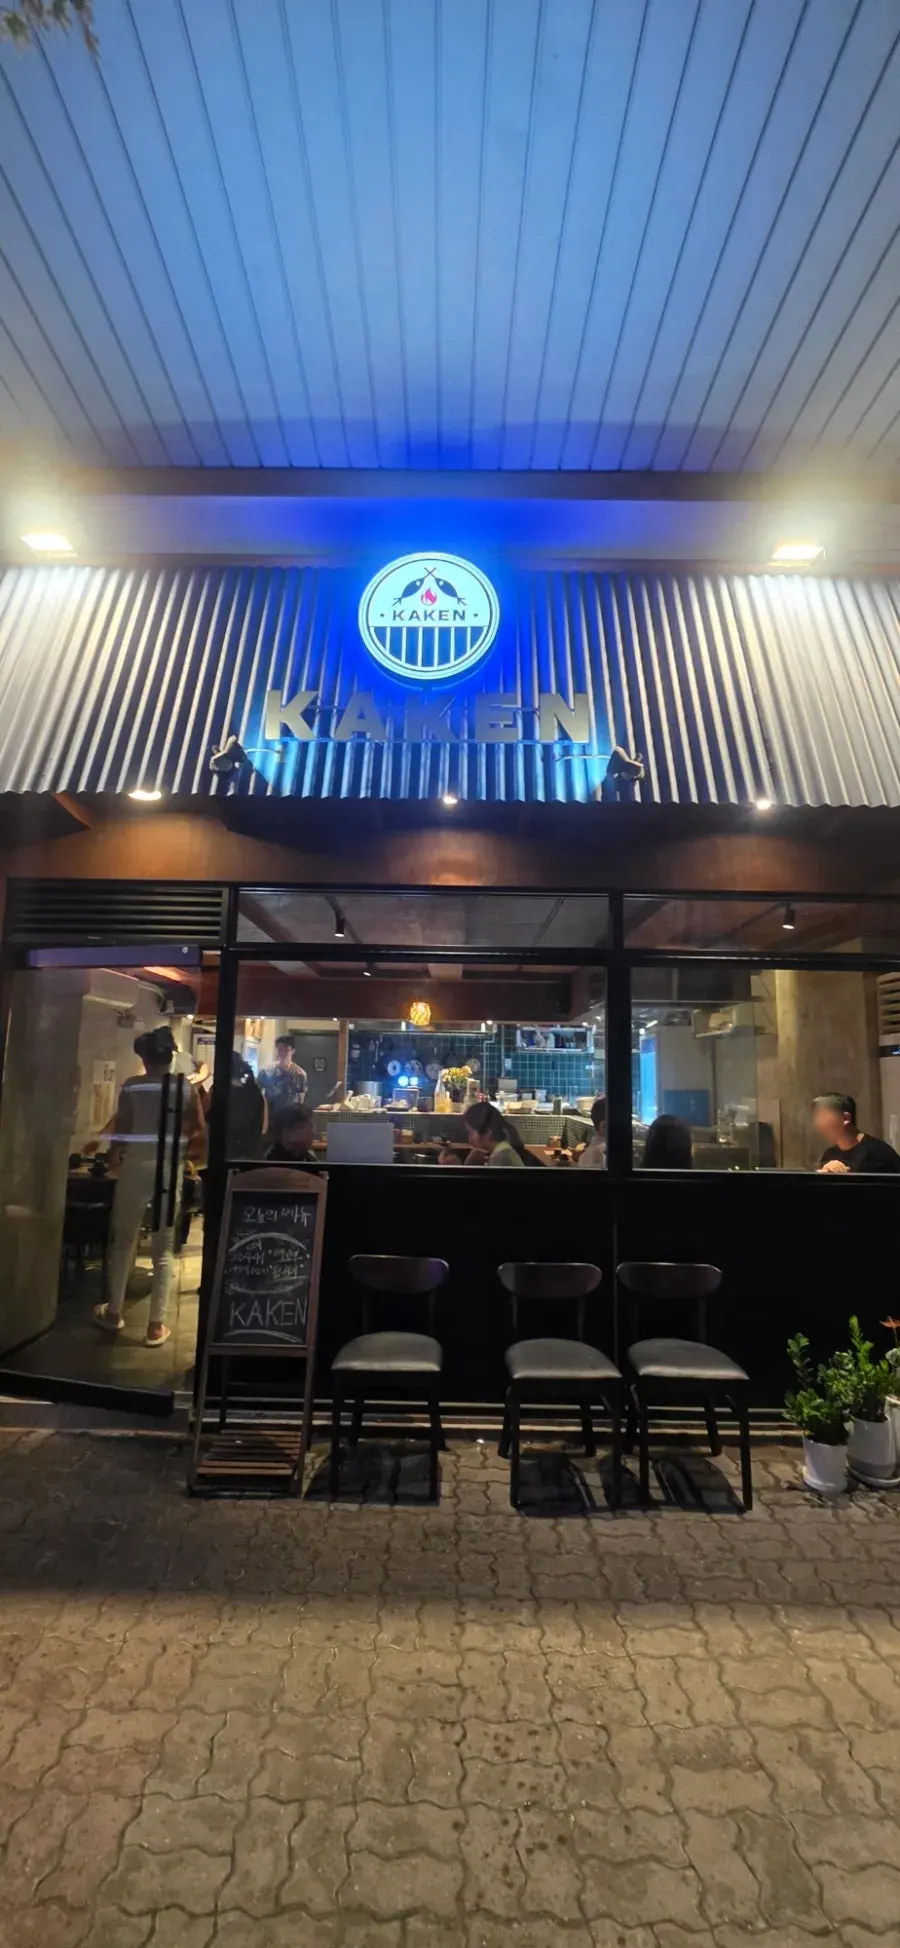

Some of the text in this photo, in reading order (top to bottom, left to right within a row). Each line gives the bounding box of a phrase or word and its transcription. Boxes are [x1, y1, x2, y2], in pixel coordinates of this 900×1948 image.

[393, 609, 466, 621] KAKEN
[264, 690, 590, 743] KAKEN
[242, 1206, 277, 1223] 오늘의
[230, 1297, 308, 1327] KAKEN
